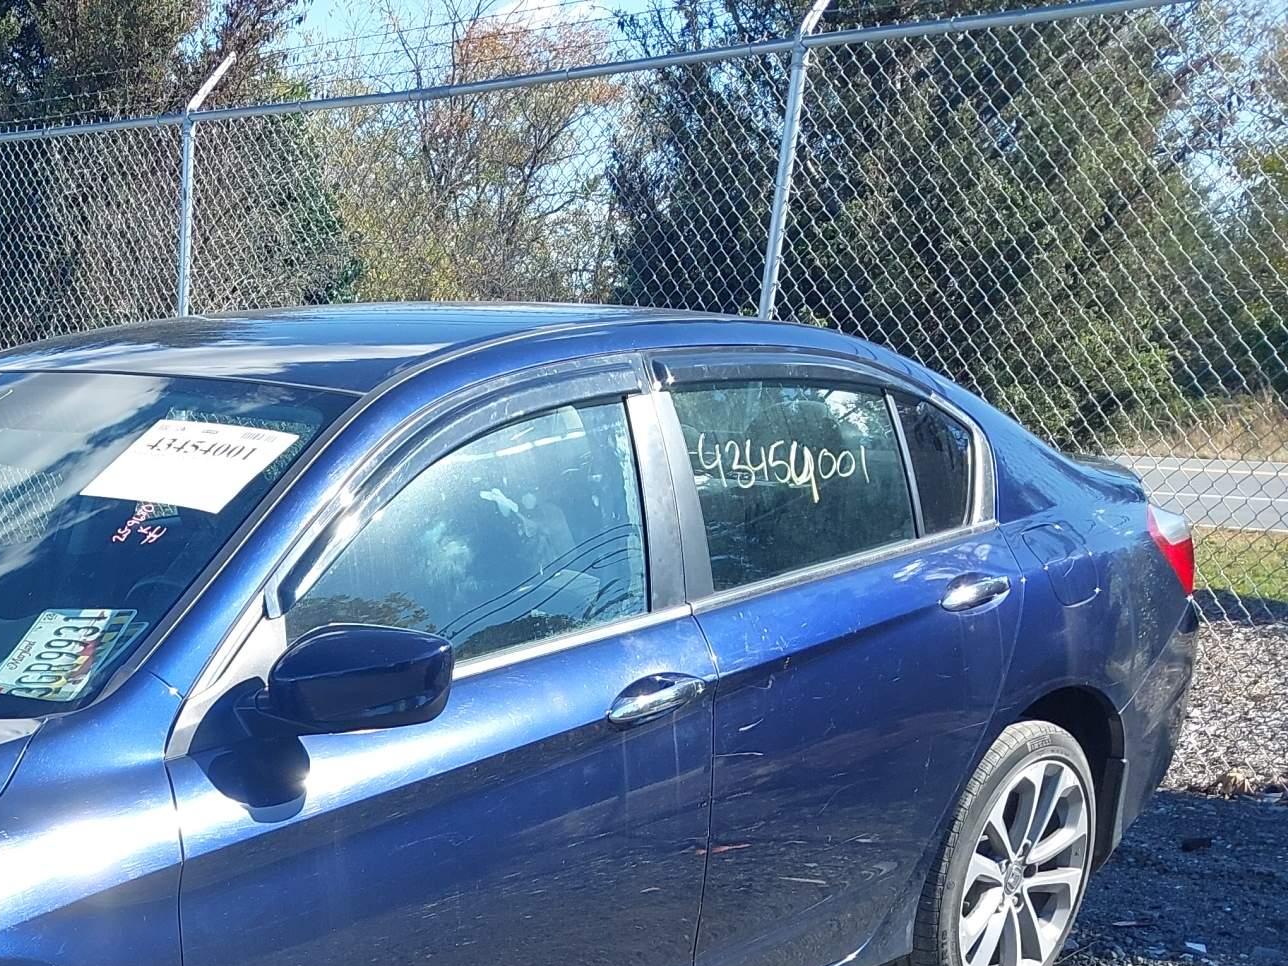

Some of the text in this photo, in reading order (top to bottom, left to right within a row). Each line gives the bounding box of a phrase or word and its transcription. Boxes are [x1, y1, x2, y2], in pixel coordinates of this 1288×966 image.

[147, 437, 258, 461] 43454001
[698, 433, 870, 503] 43454001
[6, 616, 108, 698] 3GR9931
